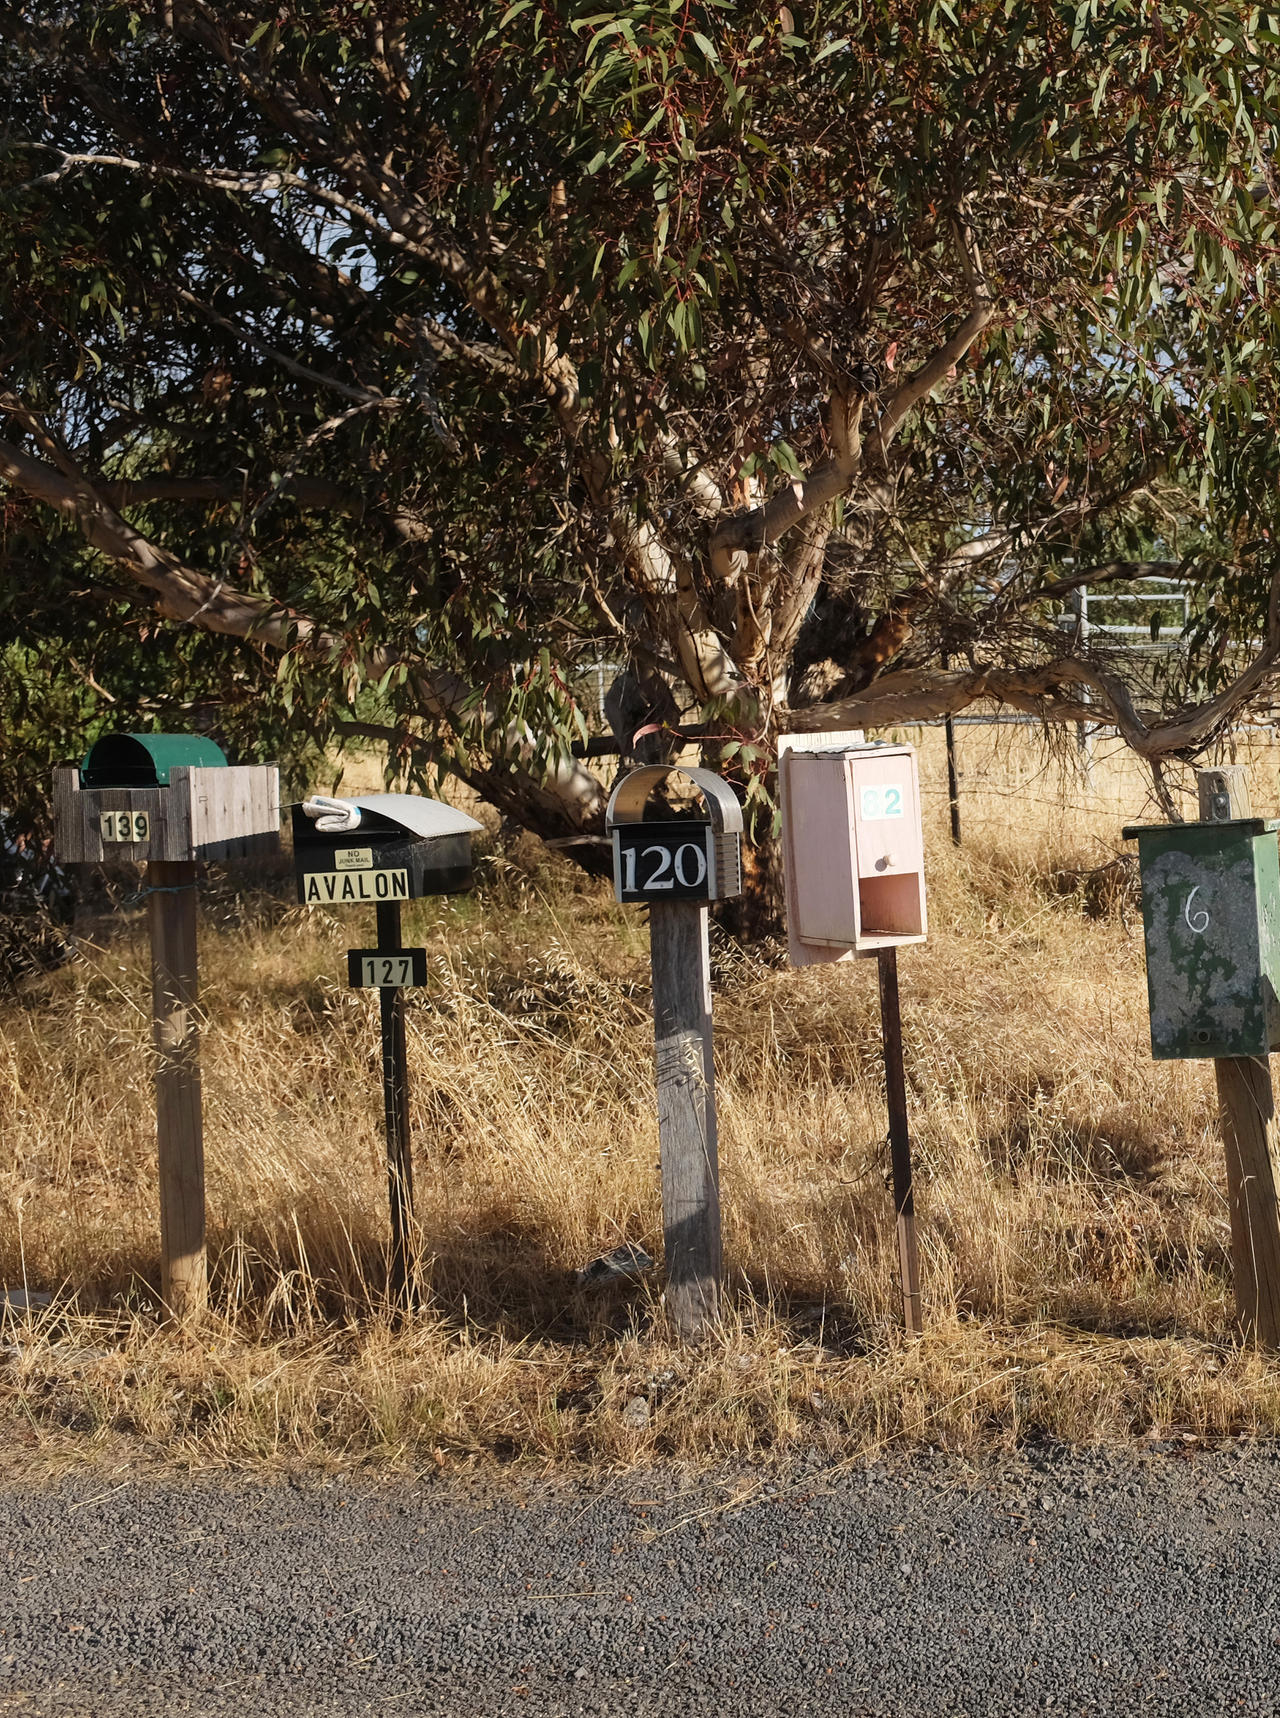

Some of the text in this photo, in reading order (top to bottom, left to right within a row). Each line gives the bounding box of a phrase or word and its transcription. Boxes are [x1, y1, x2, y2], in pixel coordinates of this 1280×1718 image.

[103, 815, 149, 838] 139
[347, 850, 360, 858] NO
[620, 843, 707, 893] 120
[307, 870, 407, 902] AVALON
[1184, 885, 1210, 934] 6
[366, 959, 410, 984] 127
